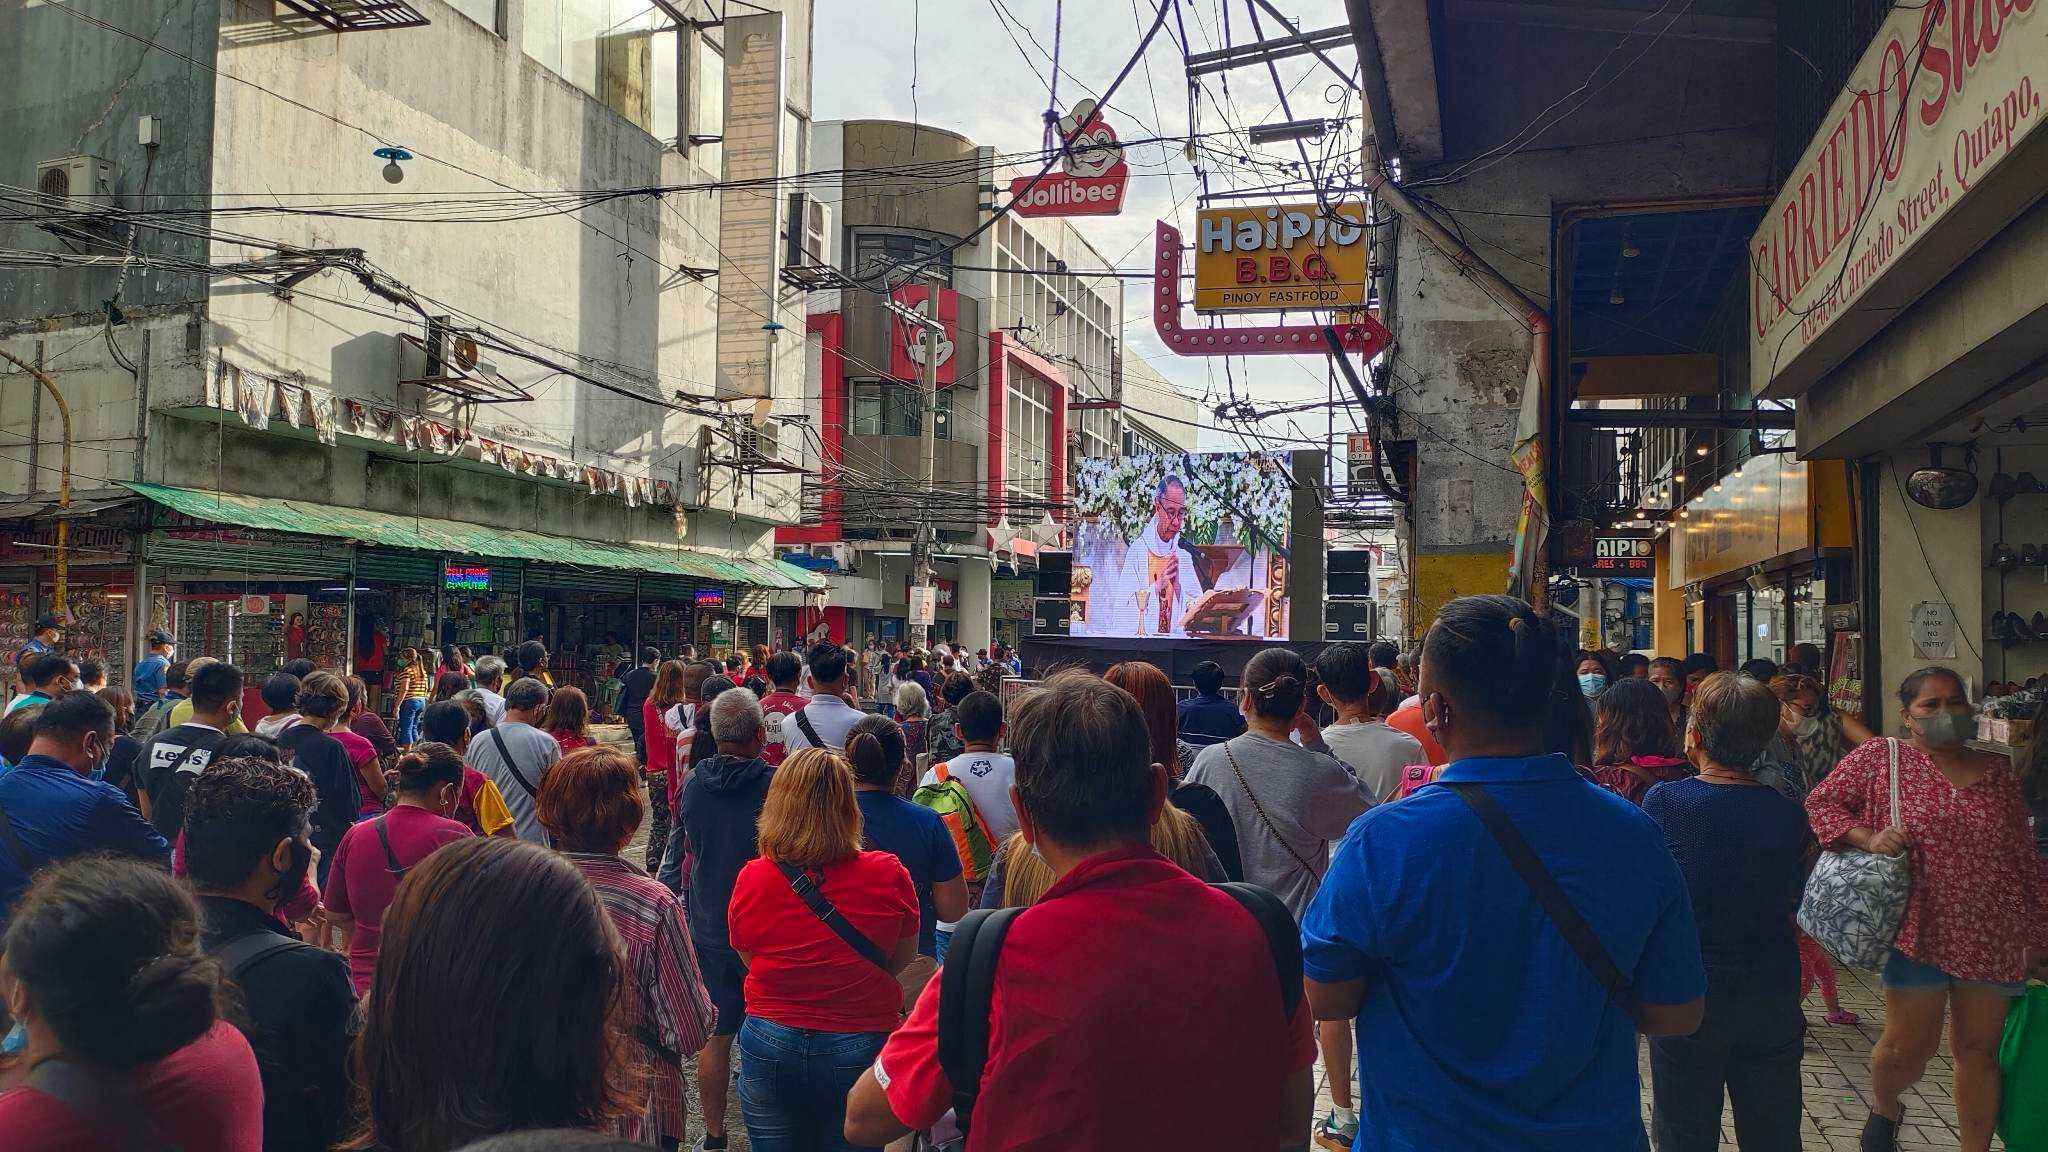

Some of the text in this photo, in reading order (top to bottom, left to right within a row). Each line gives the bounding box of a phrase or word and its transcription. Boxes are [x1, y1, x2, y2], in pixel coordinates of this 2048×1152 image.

[1018, 180, 1117, 208] Jollibee
[1755, 39, 1908, 338] CARRIEDO
[1840, 219, 1894, 304] Carriedo
[1898, 161, 1950, 246] Street,
[1954, 76, 2040, 192] Quiapo,
[1201, 207, 1363, 253] HaiPio
[1235, 253, 1337, 284] B.B.Q.
[1223, 290, 1339, 304] PINOY FASTFOOD
[445, 568, 464, 576] CELL
[446, 582, 488, 590] COMPUTER
